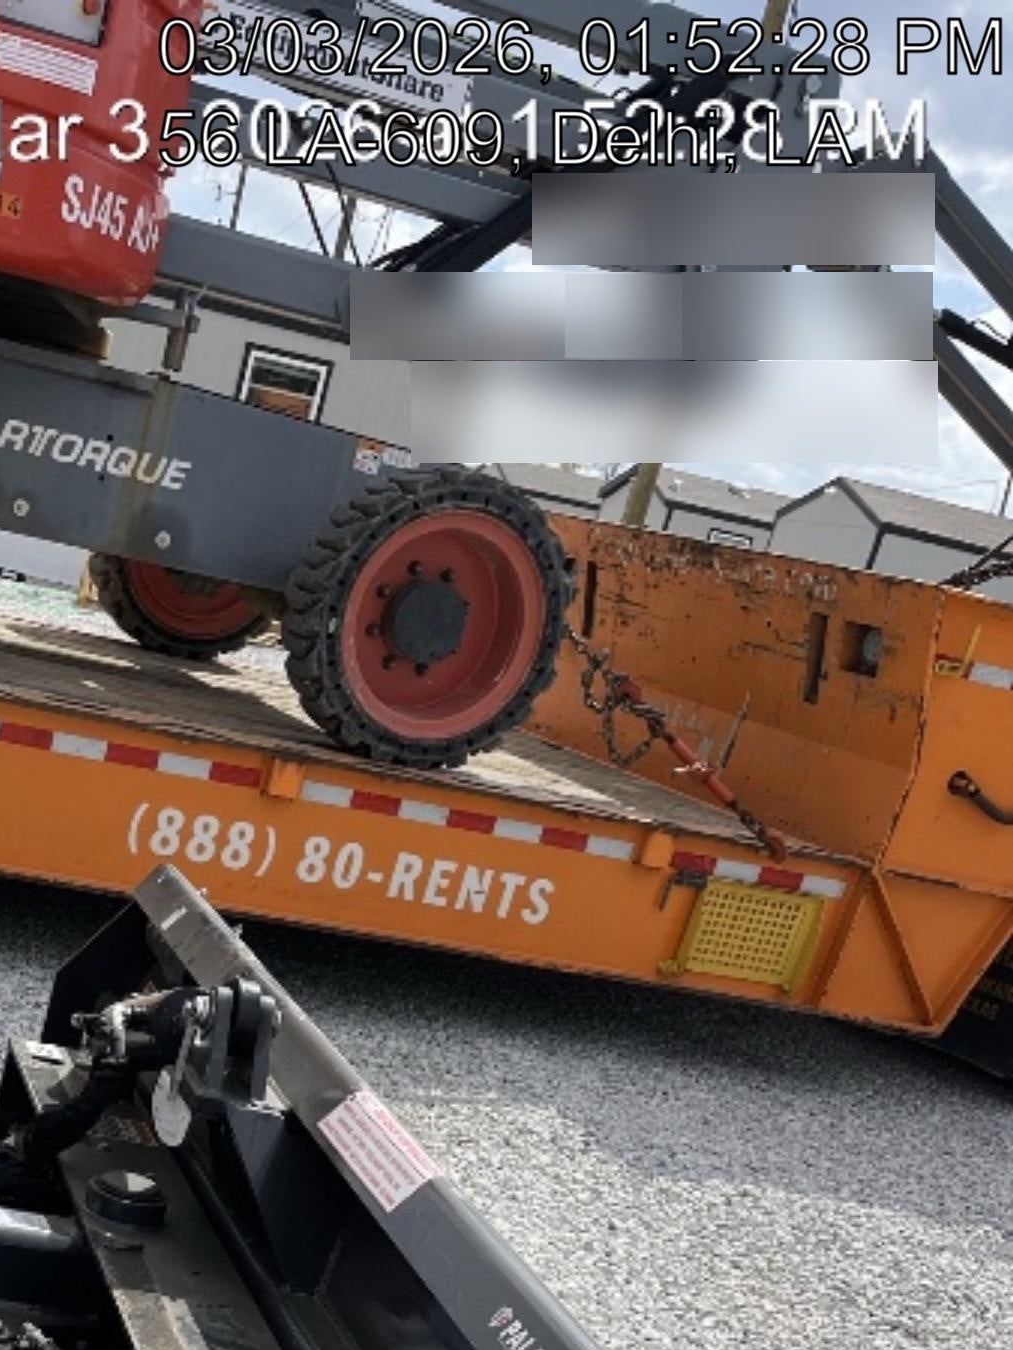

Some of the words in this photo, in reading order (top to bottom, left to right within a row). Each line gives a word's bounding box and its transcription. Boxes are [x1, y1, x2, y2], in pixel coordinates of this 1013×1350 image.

[61, 173, 129, 241] SJ45
[127, 802, 278, 878] (888)
[295, 835, 556, 926] 80-RENTS
